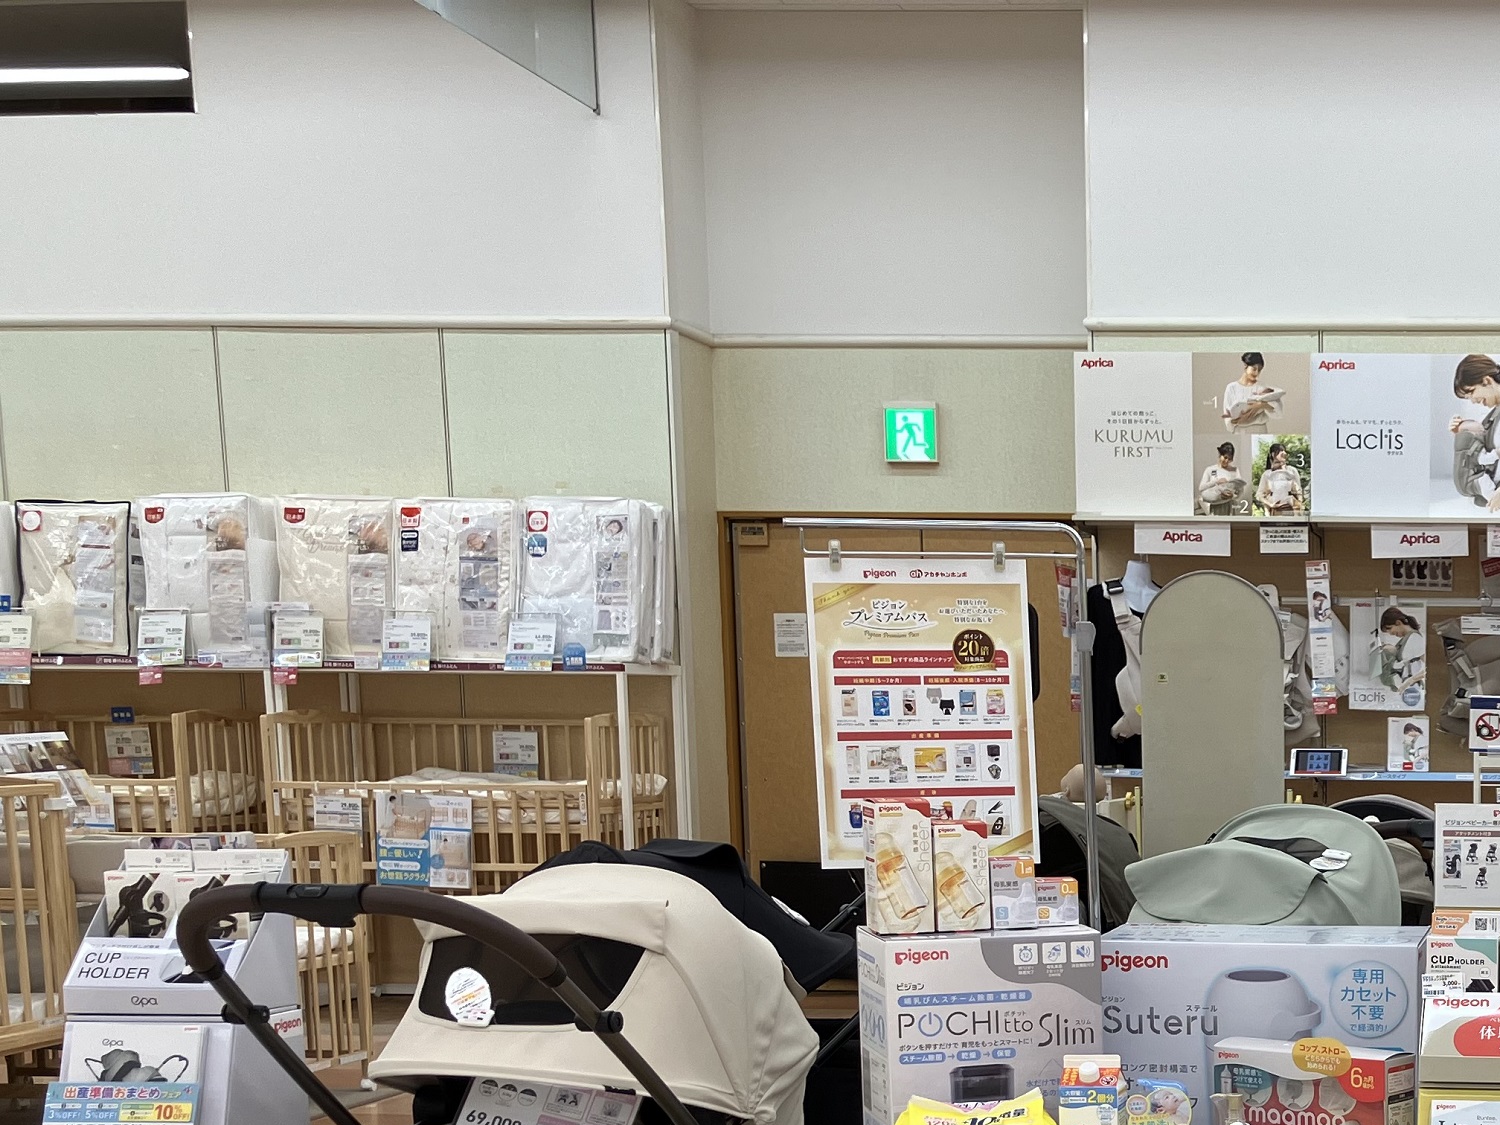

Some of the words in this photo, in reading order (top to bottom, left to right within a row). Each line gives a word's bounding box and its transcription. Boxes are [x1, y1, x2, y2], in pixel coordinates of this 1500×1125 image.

[1081, 358, 1114, 369] Aprica
[1319, 359, 1355, 371] Aprica
[1094, 429, 1173, 443] KURUMU
[1336, 428, 1403, 450] Lactis
[1114, 446, 1153, 457] FIRST
[1163, 530, 1202, 543] Aprica
[1400, 533, 1440, 544] Aprica
[863, 569, 896, 578] pigeon
[872, 600, 905, 610] ピジョン
[850, 611, 928, 623] プレミアムパス
[1353, 692, 1386, 703] Lactis
[879, 805, 902, 813] pigeon
[993, 862, 1012, 870] pigeon
[1037, 884, 1056, 892] pigeon
[84, 952, 122, 965] CUP
[895, 949, 949, 966] pigeon
[1101, 951, 1168, 972] pigeon
[1431, 956, 1454, 964] CUP
[78, 967, 149, 980] HOLDER
[1352, 968, 1385, 985] 専用
[897, 983, 925, 991] ピジョン
[131, 995, 158, 1007] epa
[1340, 988, 1396, 1003] カセット
[1351, 1005, 1385, 1021] 不要
[274, 1017, 302, 1034] pigeon
[1102, 1005, 1218, 1036] Suteru
[1038, 1013, 1094, 1048] Slim
[102, 1038, 124, 1048] epa
[1218, 1051, 1239, 1060] pigeon
